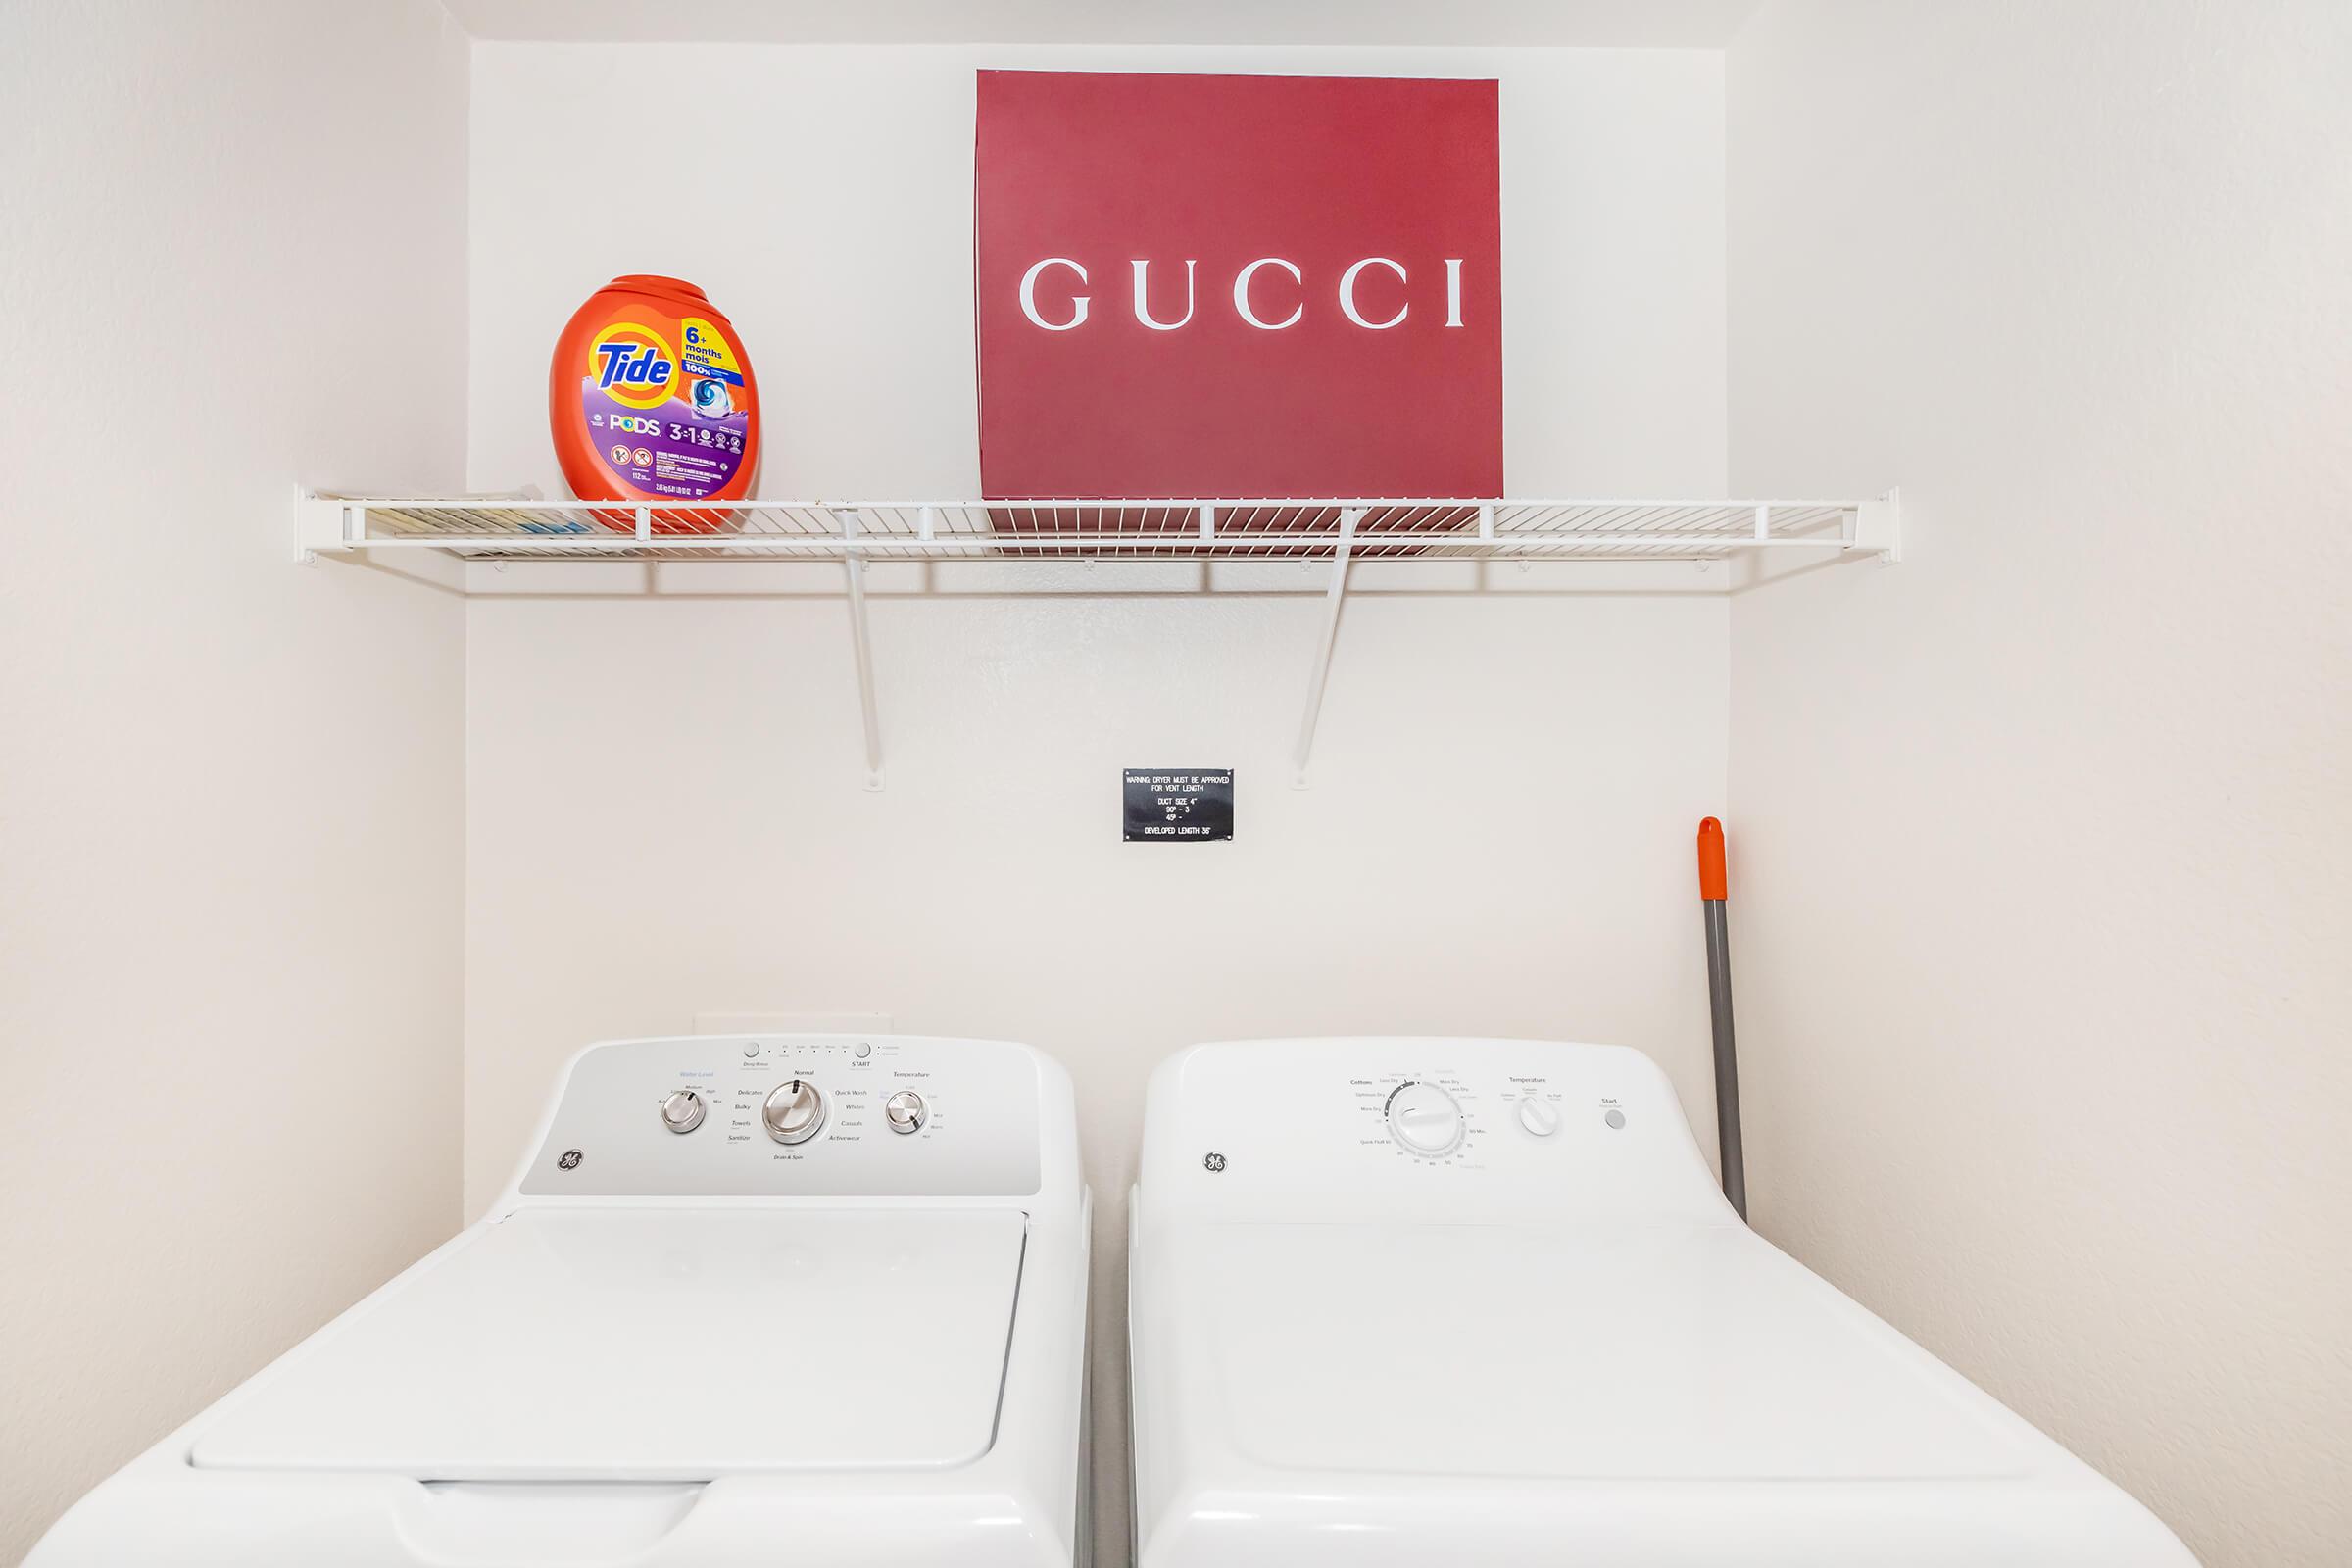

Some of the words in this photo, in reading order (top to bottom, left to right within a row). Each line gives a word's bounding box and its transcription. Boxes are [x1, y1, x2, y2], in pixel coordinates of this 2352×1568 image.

[1019, 257, 1464, 331] GUCCI
[685, 344, 722, 360] months
[685, 353, 709, 364] mois
[597, 344, 672, 389] Tide
[609, 414, 661, 437] PODS
